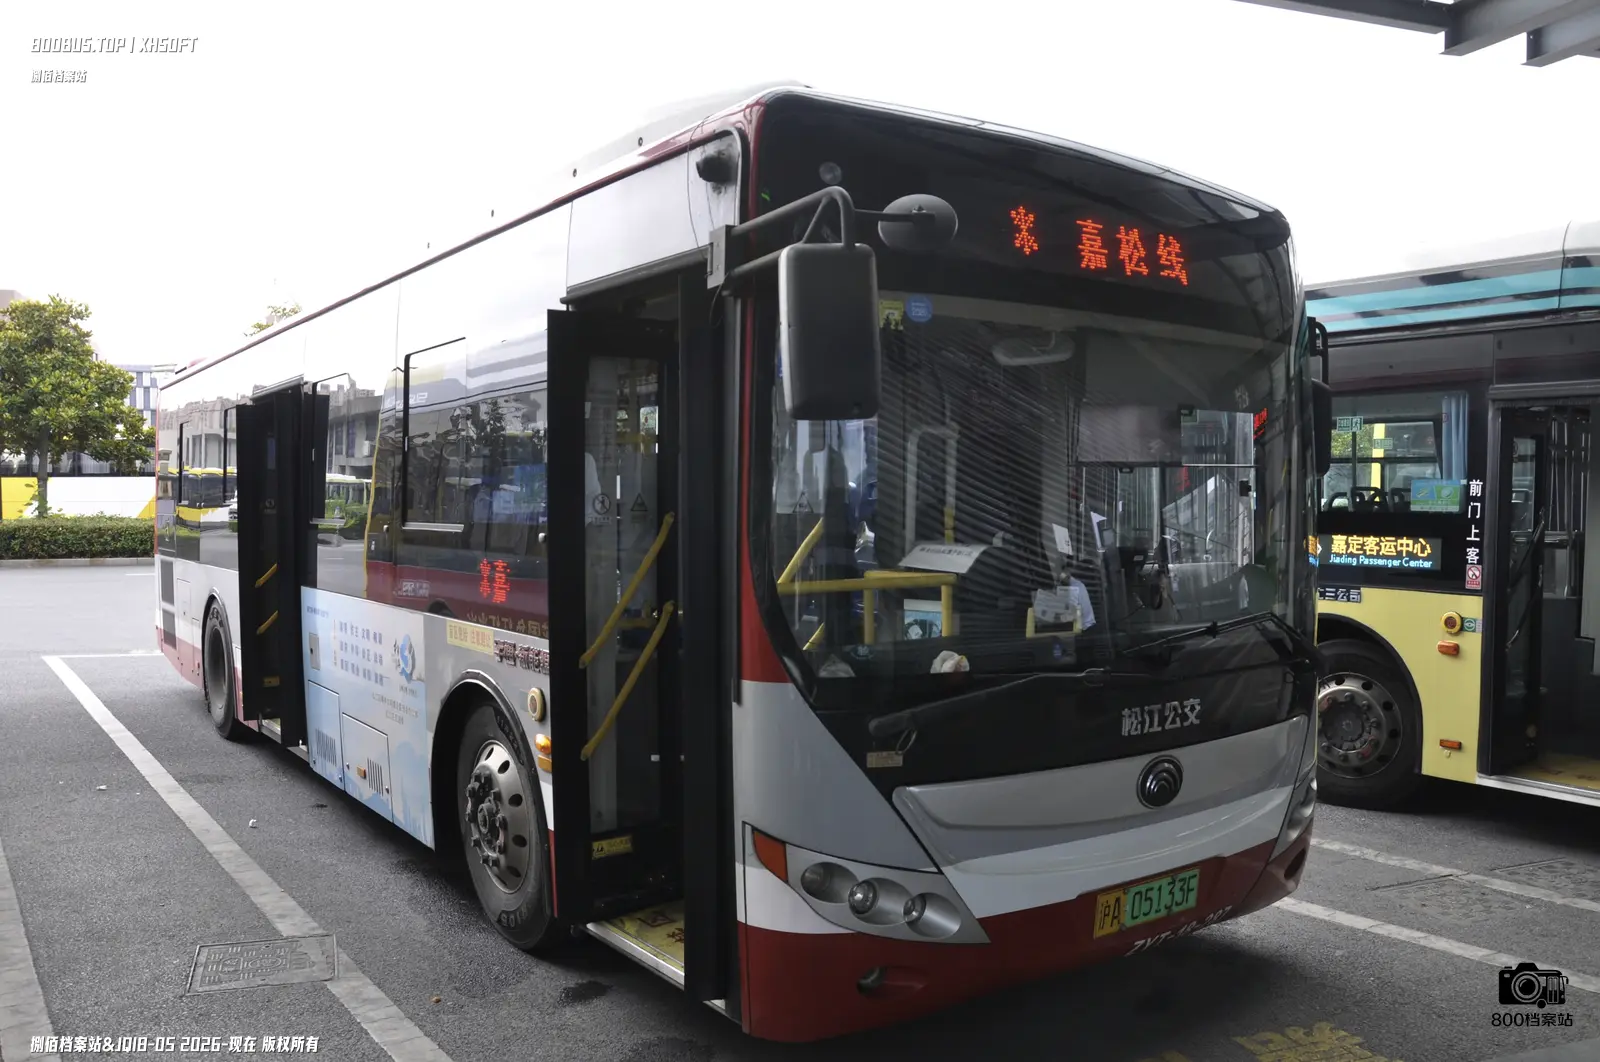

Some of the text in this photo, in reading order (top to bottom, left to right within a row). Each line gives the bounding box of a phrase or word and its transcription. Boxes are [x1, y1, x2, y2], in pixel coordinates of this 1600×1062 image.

[1076, 219, 1188, 286] 嘉松线
[1466, 479, 1483, 564] 前门上客
[1329, 554, 1432, 568] Jiading Passenger Center
[1331, 534, 1432, 557] 嘉定客运中心
[1121, 698, 1201, 737] 松江公交
[1131, 873, 1198, 920] 05133F
